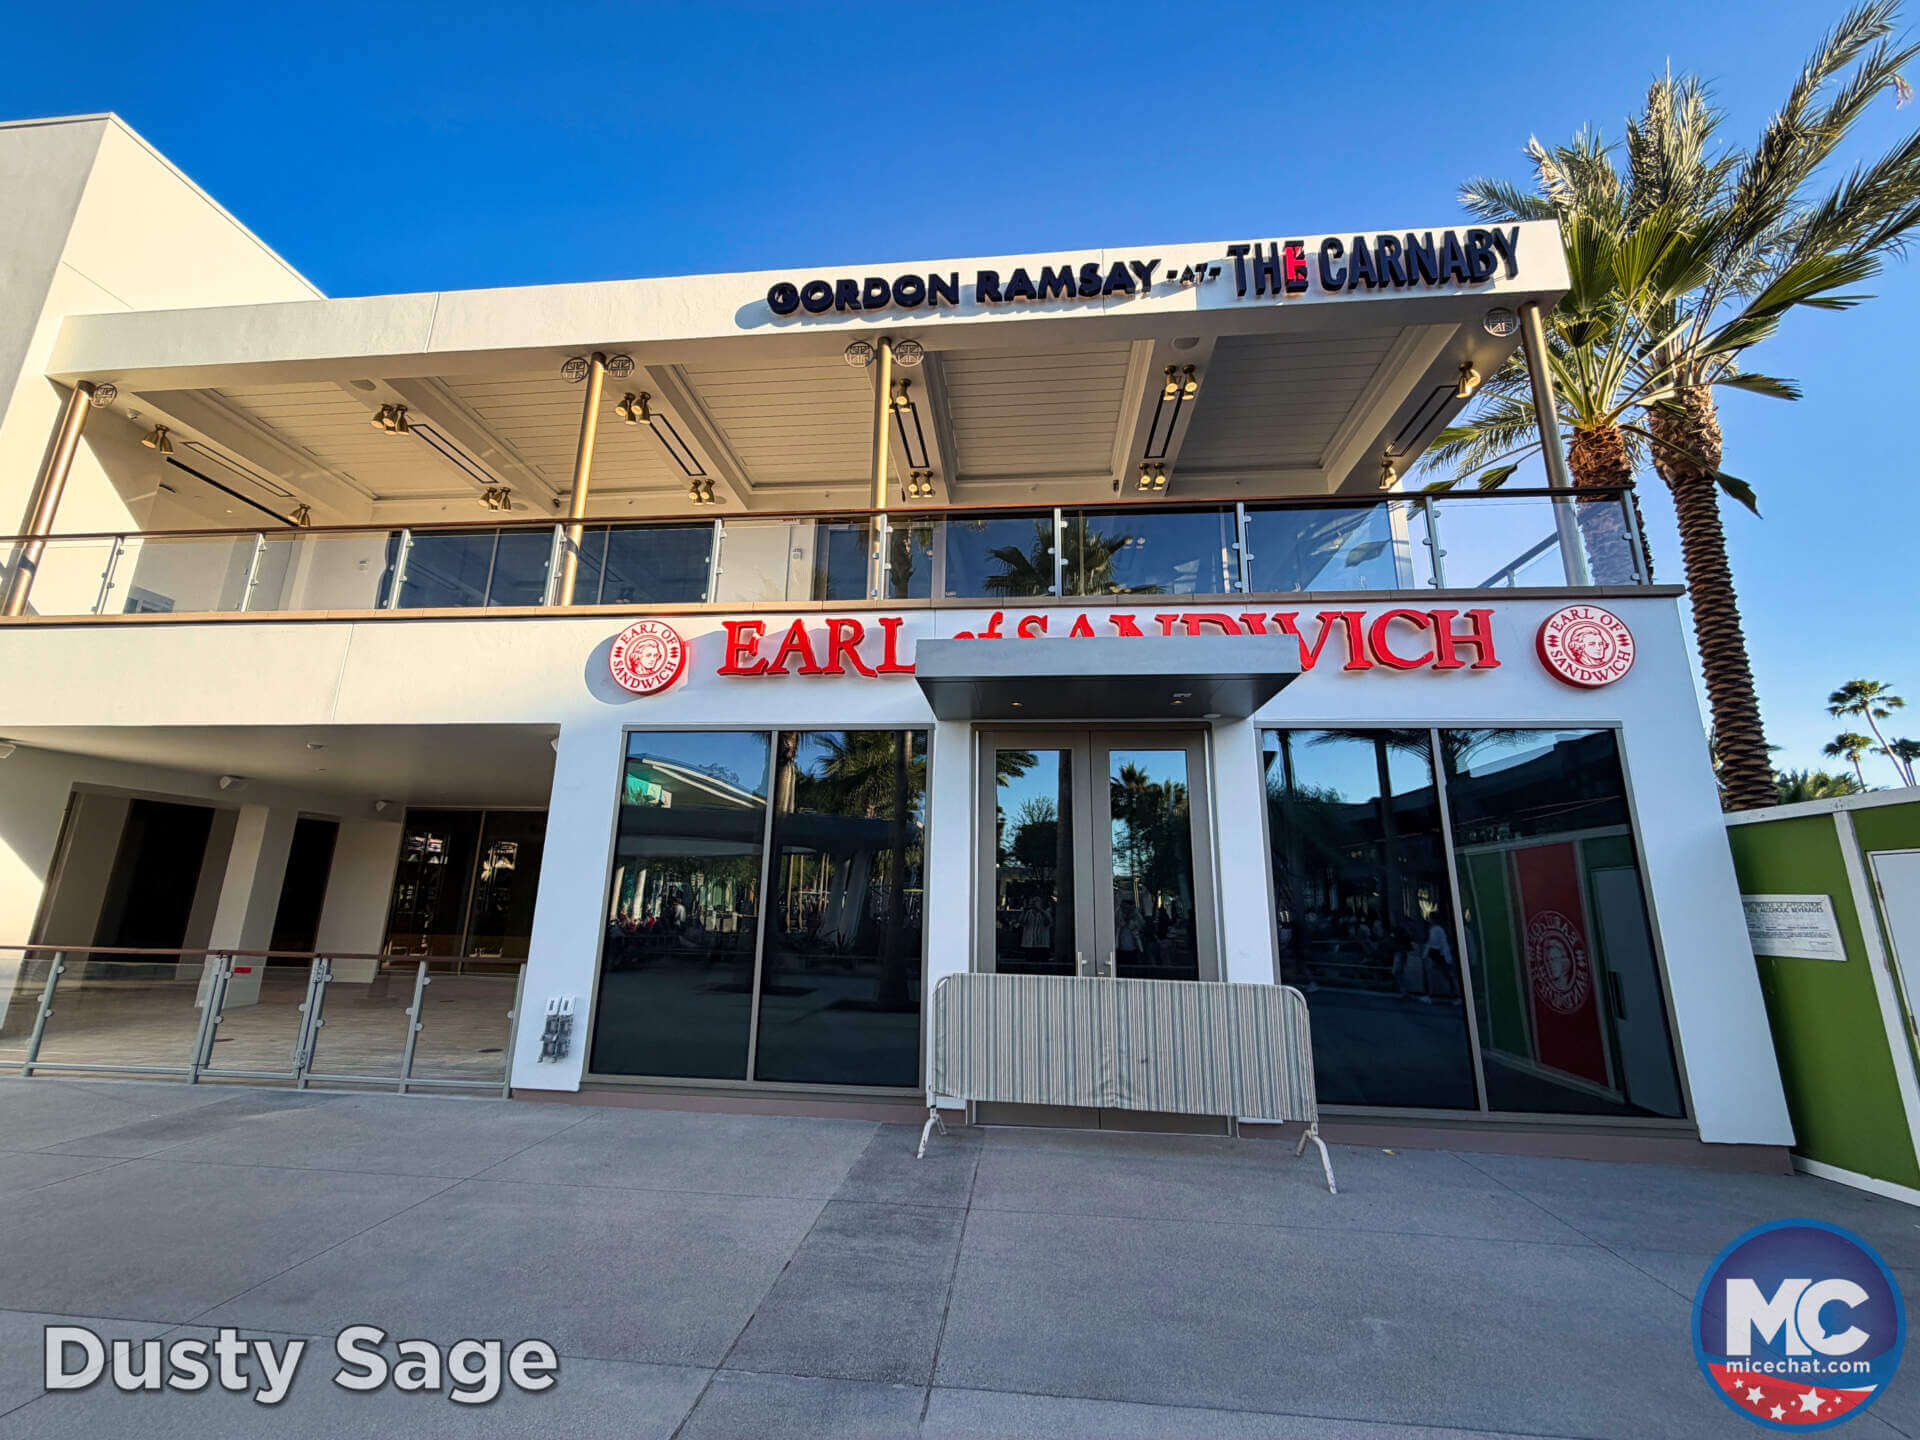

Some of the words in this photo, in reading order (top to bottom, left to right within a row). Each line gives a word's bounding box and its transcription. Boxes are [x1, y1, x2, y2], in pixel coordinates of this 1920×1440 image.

[767, 271, 960, 316] GORDON
[976, 258, 1161, 304] RAMSAY
[1227, 240, 1309, 297] THE
[1318, 226, 1520, 292] CARNABY
[620, 623, 657, 645] EARL
[661, 629, 678, 644] OF
[1550, 608, 1594, 633] EARL
[1600, 614, 1623, 632] OF
[717, 616, 916, 677] EARL
[613, 660, 677, 688] SANDWICH
[1551, 649, 1631, 681] SANDWICH
